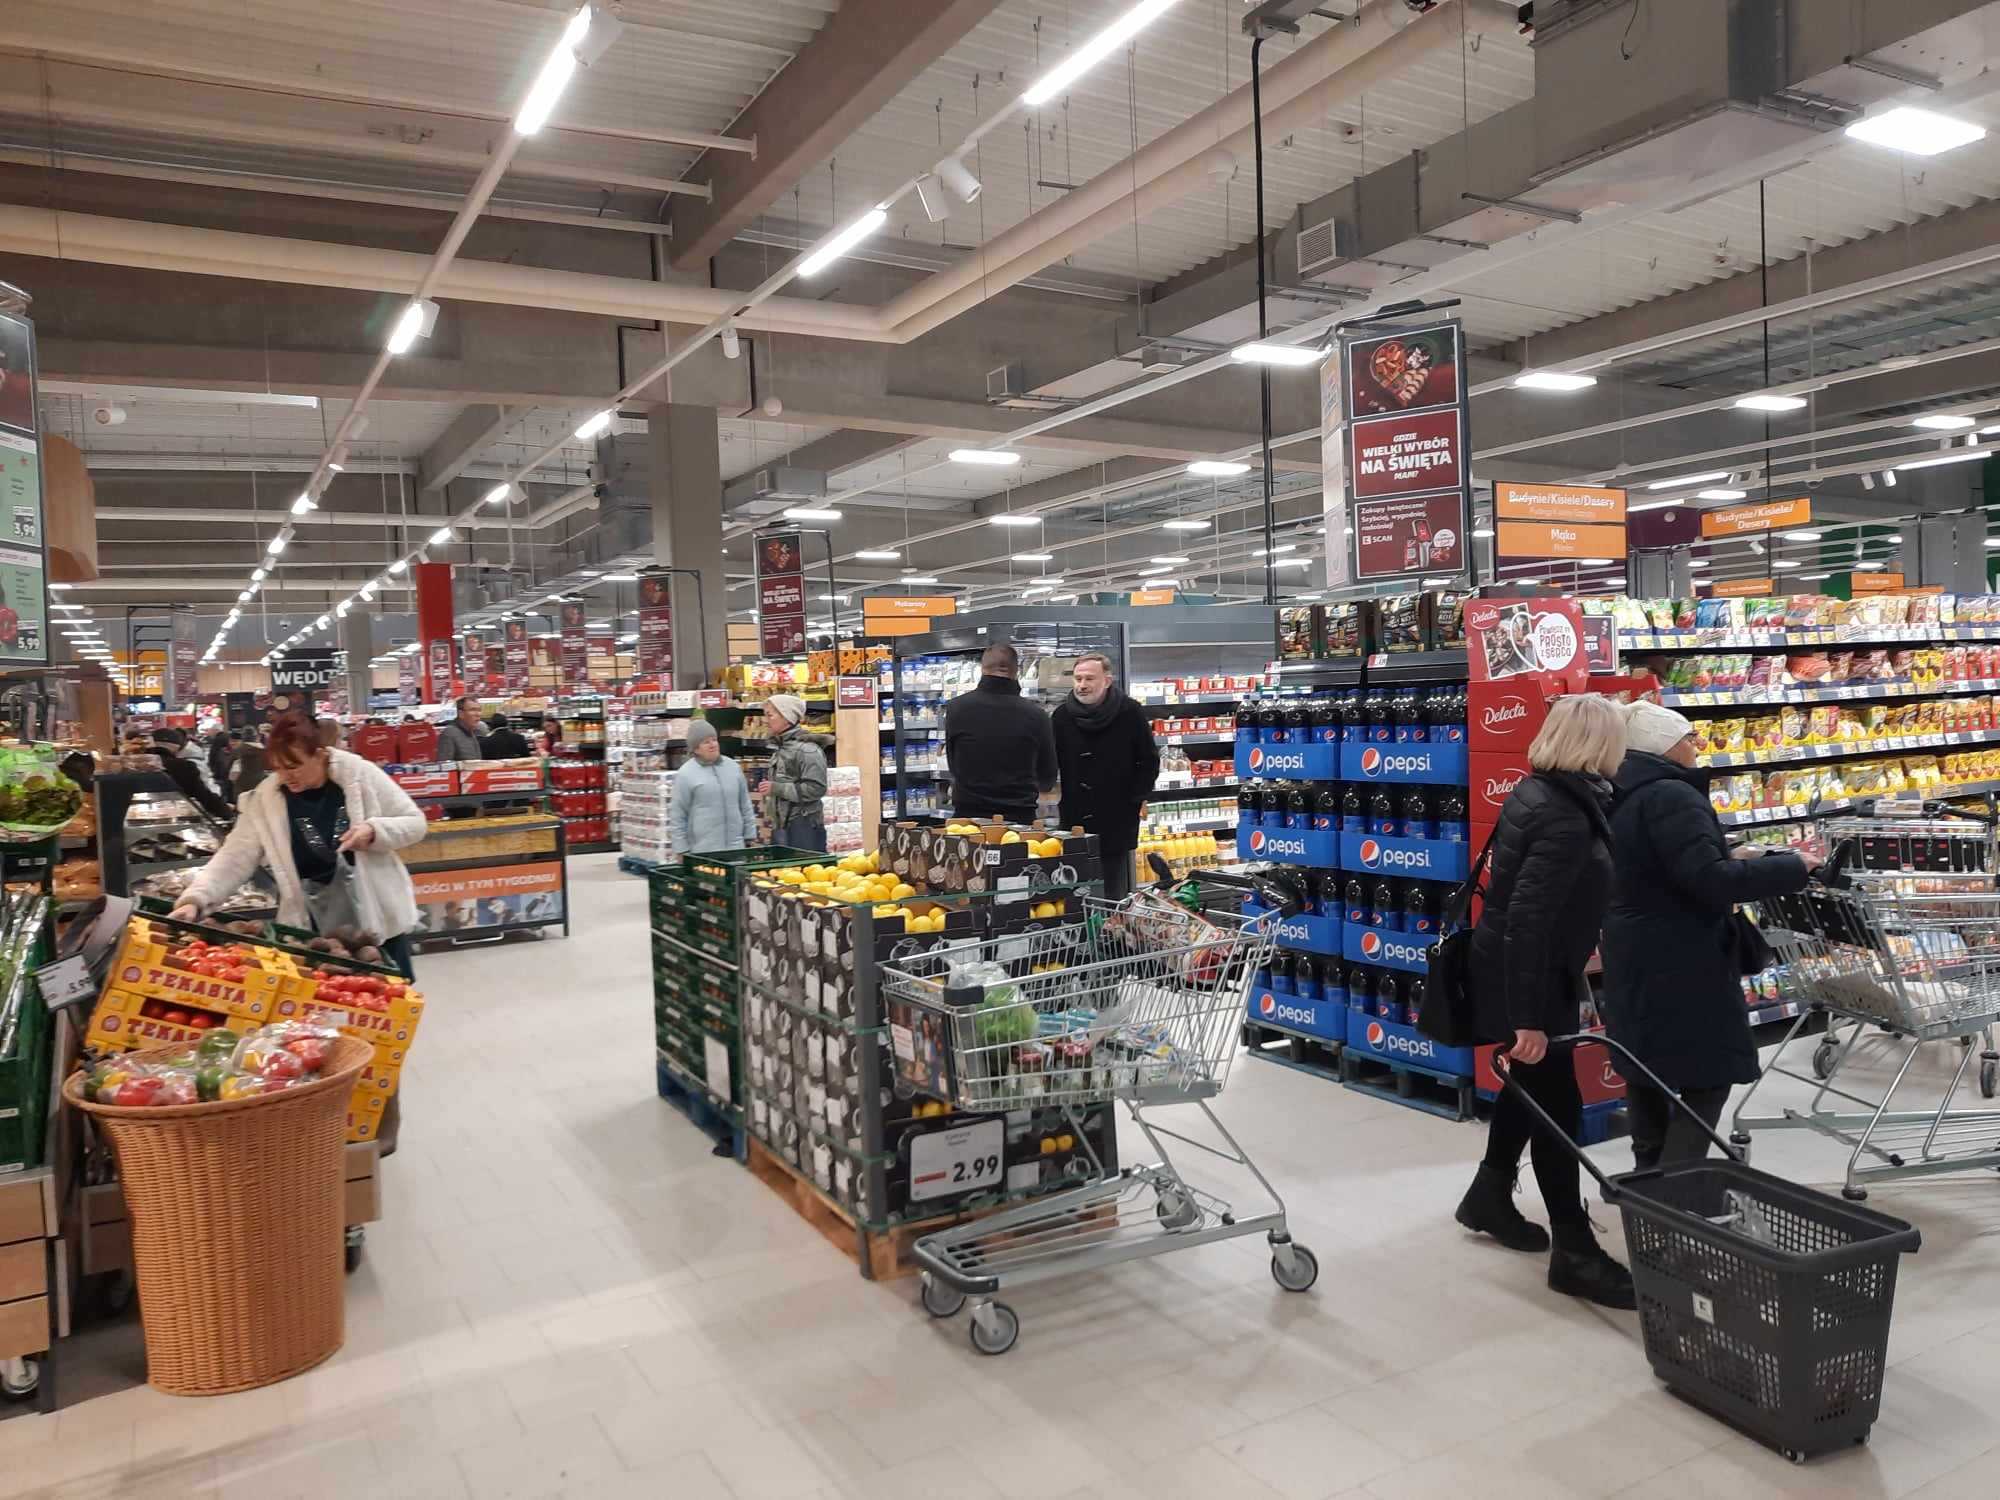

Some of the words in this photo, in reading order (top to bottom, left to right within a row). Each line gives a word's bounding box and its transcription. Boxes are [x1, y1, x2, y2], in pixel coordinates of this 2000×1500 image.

[1362, 442, 1402, 458] WIELKI
[1404, 436, 1450, 453] WYBÓR
[1360, 458, 1386, 475] NA
[1388, 450, 1453, 471] ŚWIĘTA
[1372, 534, 1392, 543] SCAN
[1484, 702, 1528, 725] Delecta
[1266, 752, 1304, 773] pepsi
[1383, 752, 1431, 775] pepsi
[1268, 838, 1305, 856] pepsi
[1383, 848, 1430, 870] pepsi
[1384, 941, 1427, 965] peps
[1277, 1003, 1316, 1025] pepsi
[1387, 1034, 1435, 1058] pepsi
[952, 1154, 999, 1184] 2.99
